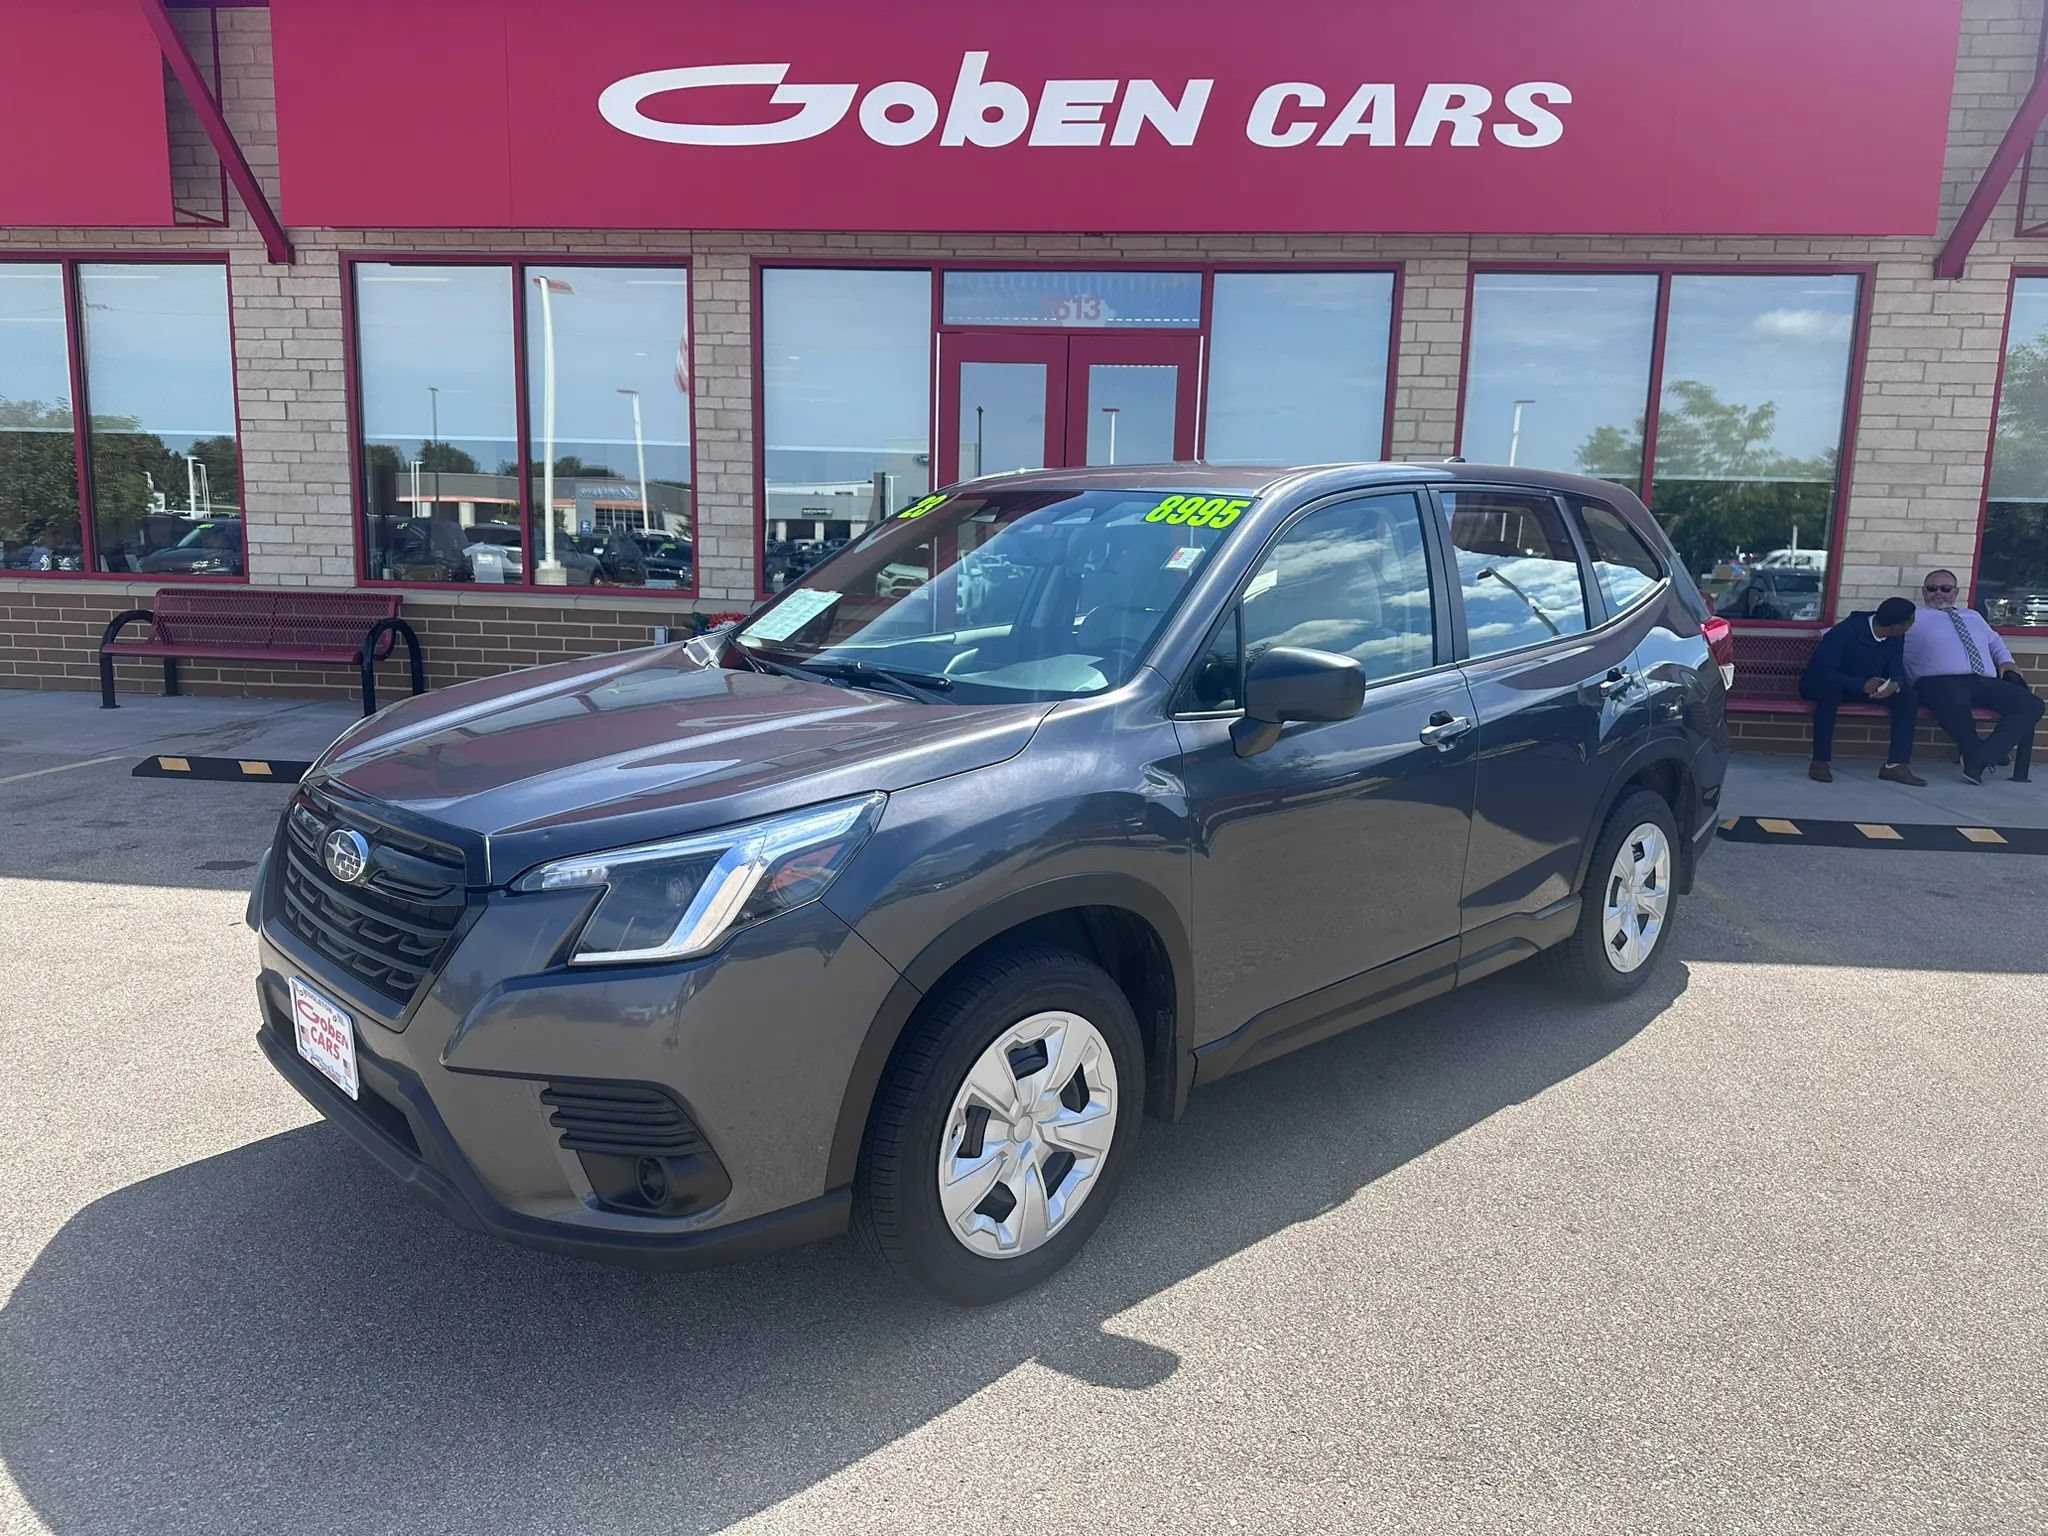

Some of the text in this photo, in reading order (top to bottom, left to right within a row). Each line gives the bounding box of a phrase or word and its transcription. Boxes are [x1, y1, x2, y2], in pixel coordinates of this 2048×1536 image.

[1247, 82, 1573, 147] CARS
[1145, 495, 1251, 529] 8995
[310, 1026, 340, 1061] CARS
